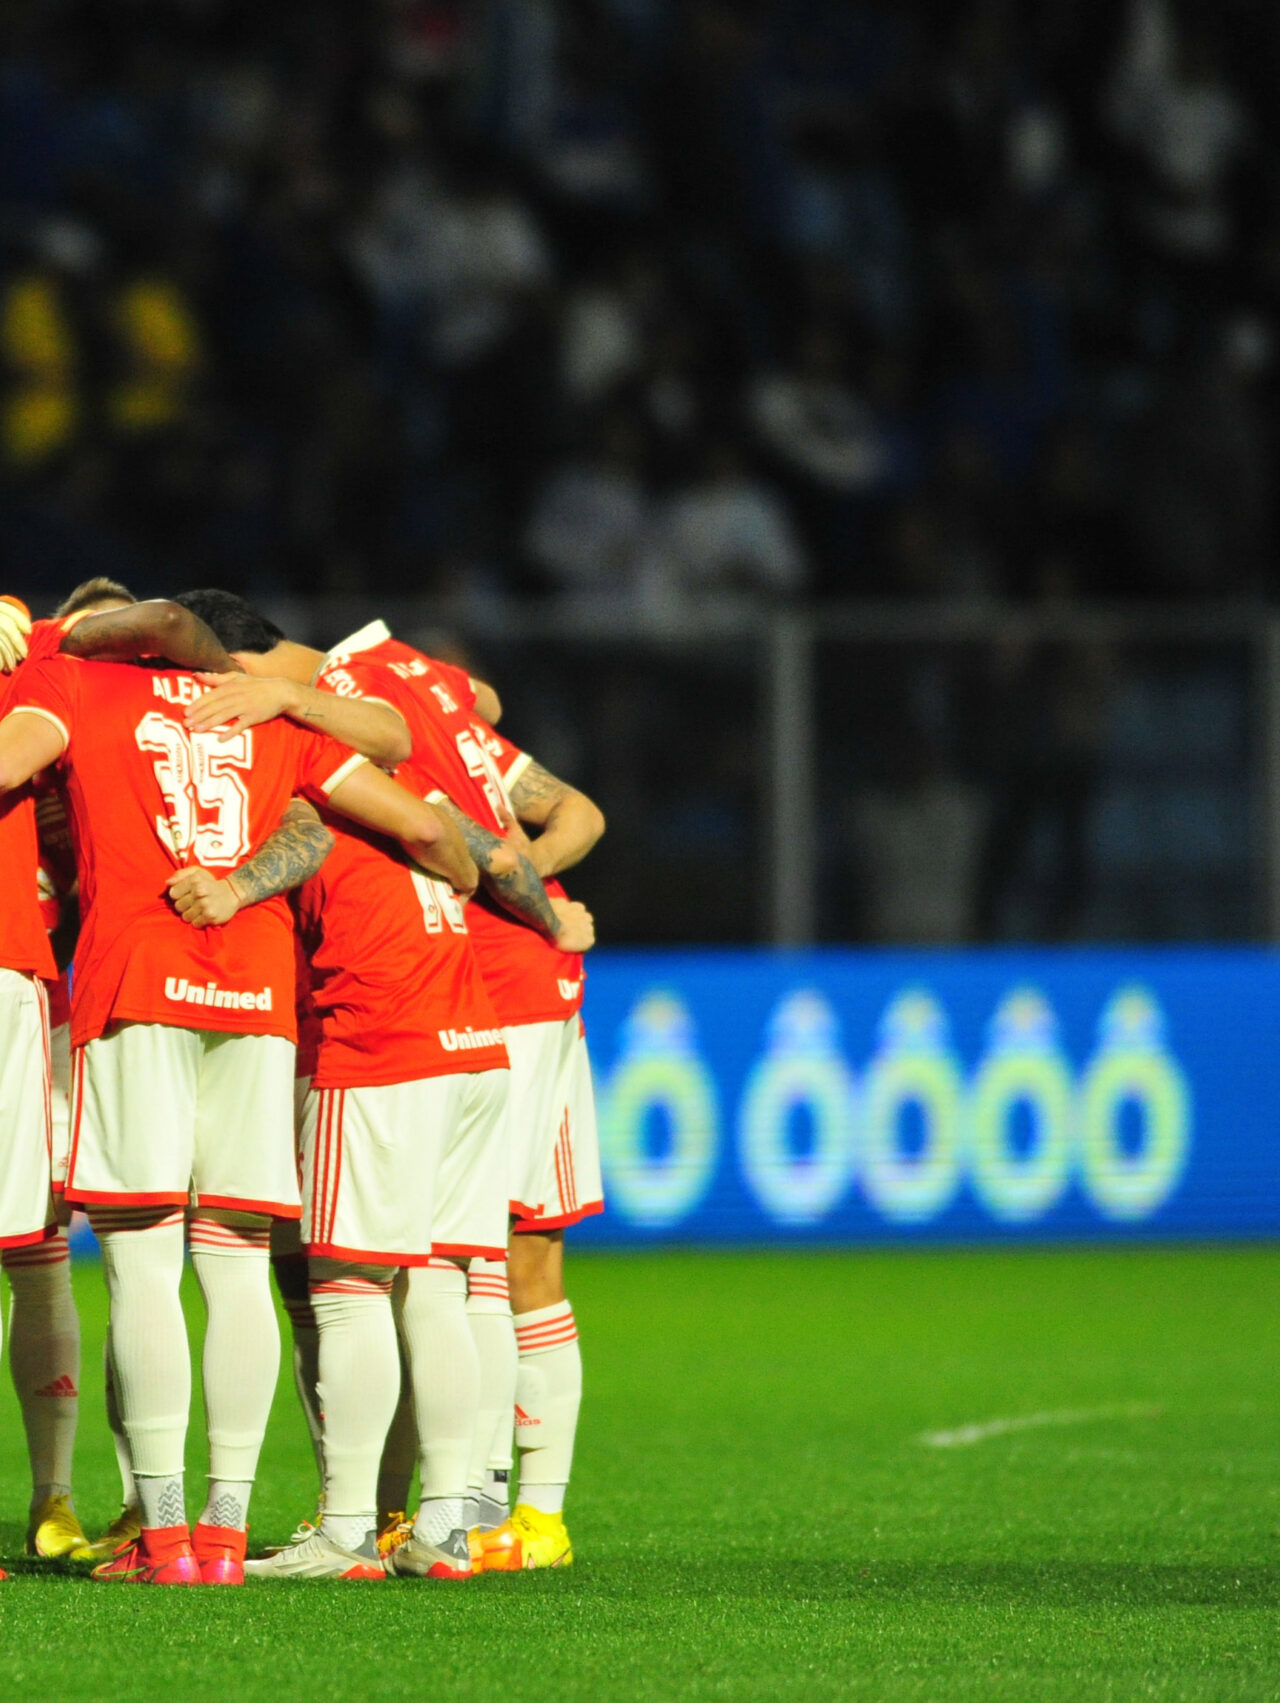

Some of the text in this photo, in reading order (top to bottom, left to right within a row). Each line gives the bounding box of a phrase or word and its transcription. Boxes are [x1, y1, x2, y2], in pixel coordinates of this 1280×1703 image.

[134, 711, 253, 867] 35
[164, 976, 273, 1012] Unimed
[437, 1026, 506, 1052] Unime
